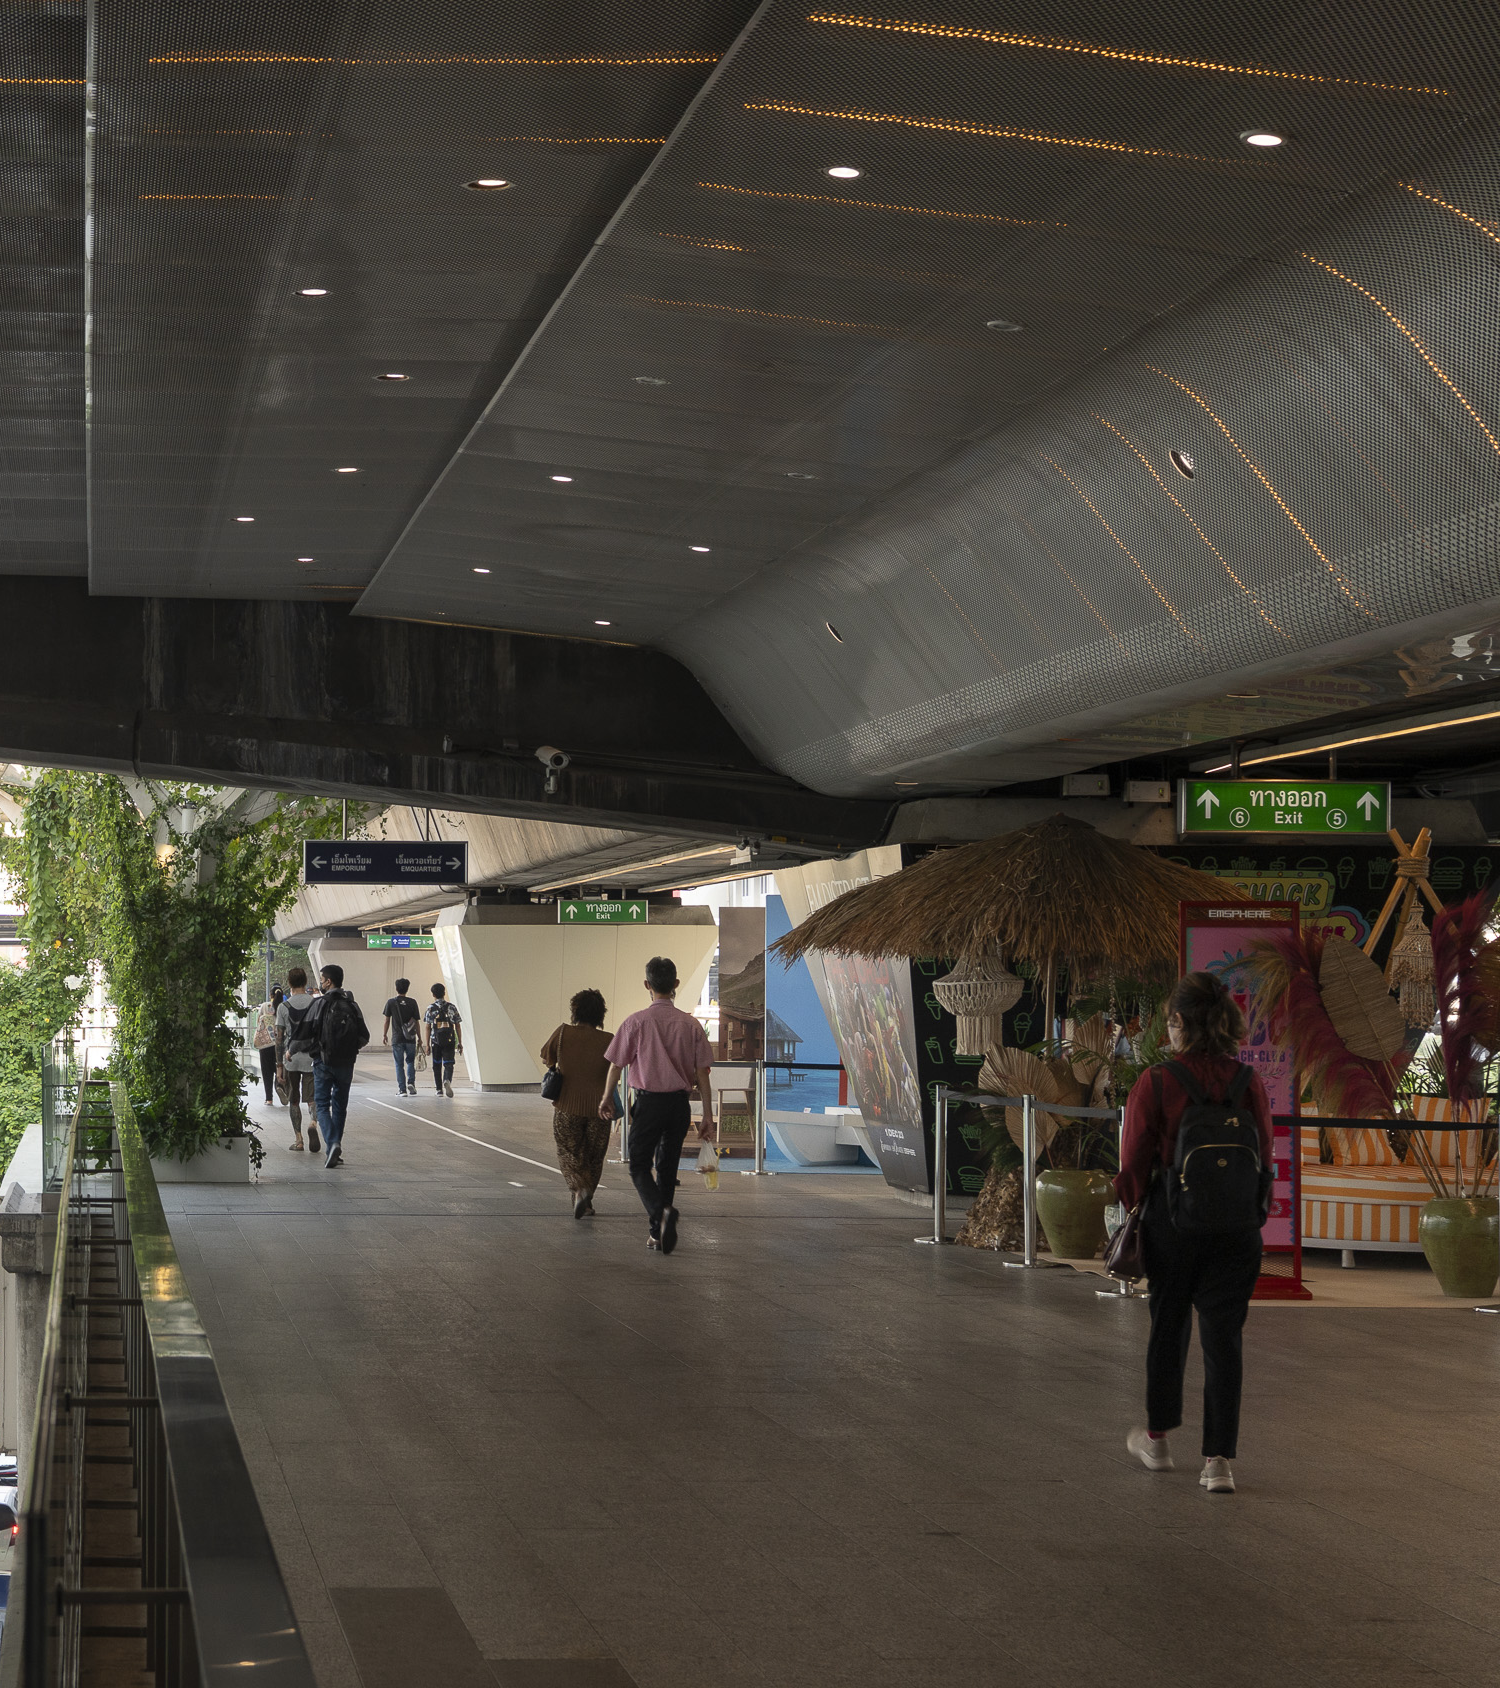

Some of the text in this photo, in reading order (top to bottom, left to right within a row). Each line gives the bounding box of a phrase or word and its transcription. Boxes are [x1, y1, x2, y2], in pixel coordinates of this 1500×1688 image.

[1249, 790, 1327, 808] ทางออก
[1274, 811, 1303, 825] Exit
[400, 865, 442, 873] EMQUARTIER
[585, 903, 622, 913] ทางออก
[596, 912, 611, 920] Exit
[1208, 909, 1271, 919] EMSPHERE
